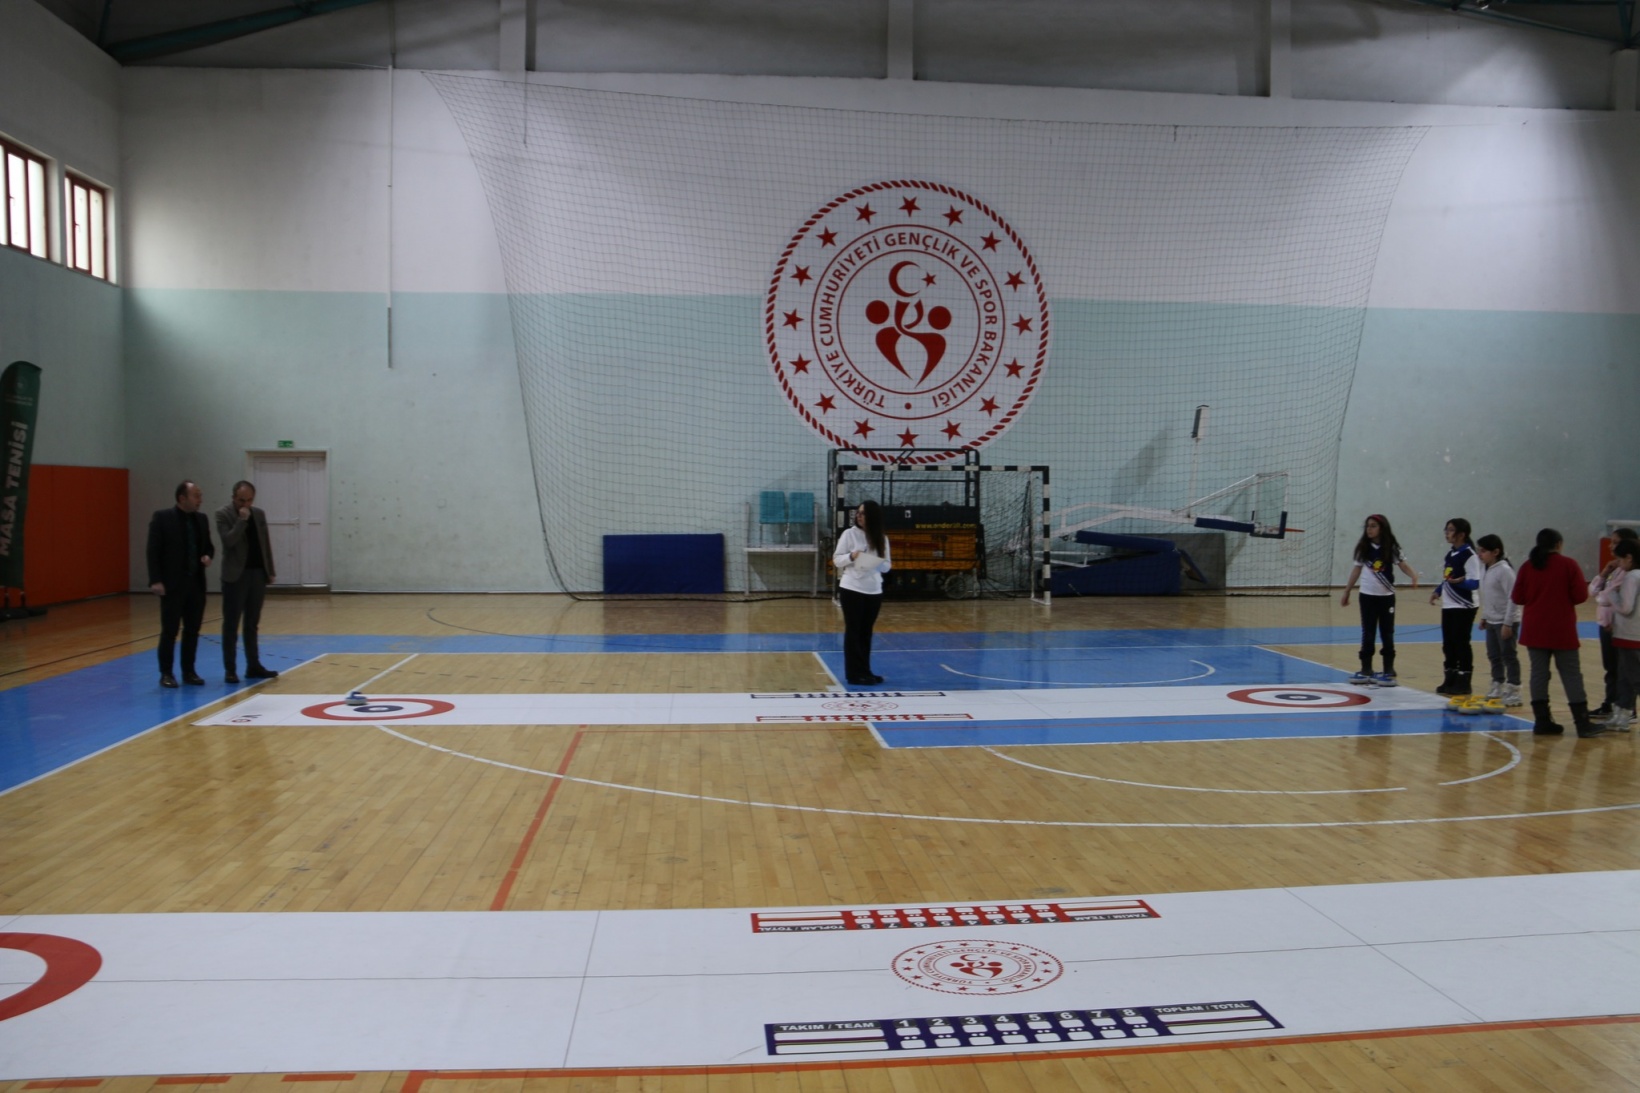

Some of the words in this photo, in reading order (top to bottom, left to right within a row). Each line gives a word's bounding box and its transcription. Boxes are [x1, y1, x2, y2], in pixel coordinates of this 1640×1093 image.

[884, 232, 961, 260] GENÇLİK
[960, 255, 981, 279] VE
[819, 235, 881, 347] CUMHURİYETİ
[974, 278, 998, 325] SPOR
[825, 349, 886, 408] TÜRKİYE
[931, 330, 998, 408] BAKANLIĞI
[7, 421, 28, 489] TENİSİ
[0, 495, 17, 557] MASA
[899, 1019, 909, 1027] 1
[931, 1018, 945, 1026] 2
[996, 1015, 1009, 1023] 4
[1028, 1013, 1041, 1021] 5
[1060, 1012, 1073, 1020] 6
[1090, 1010, 1102, 1018] 7
[1154, 1005, 1205, 1013] TOPLAM
